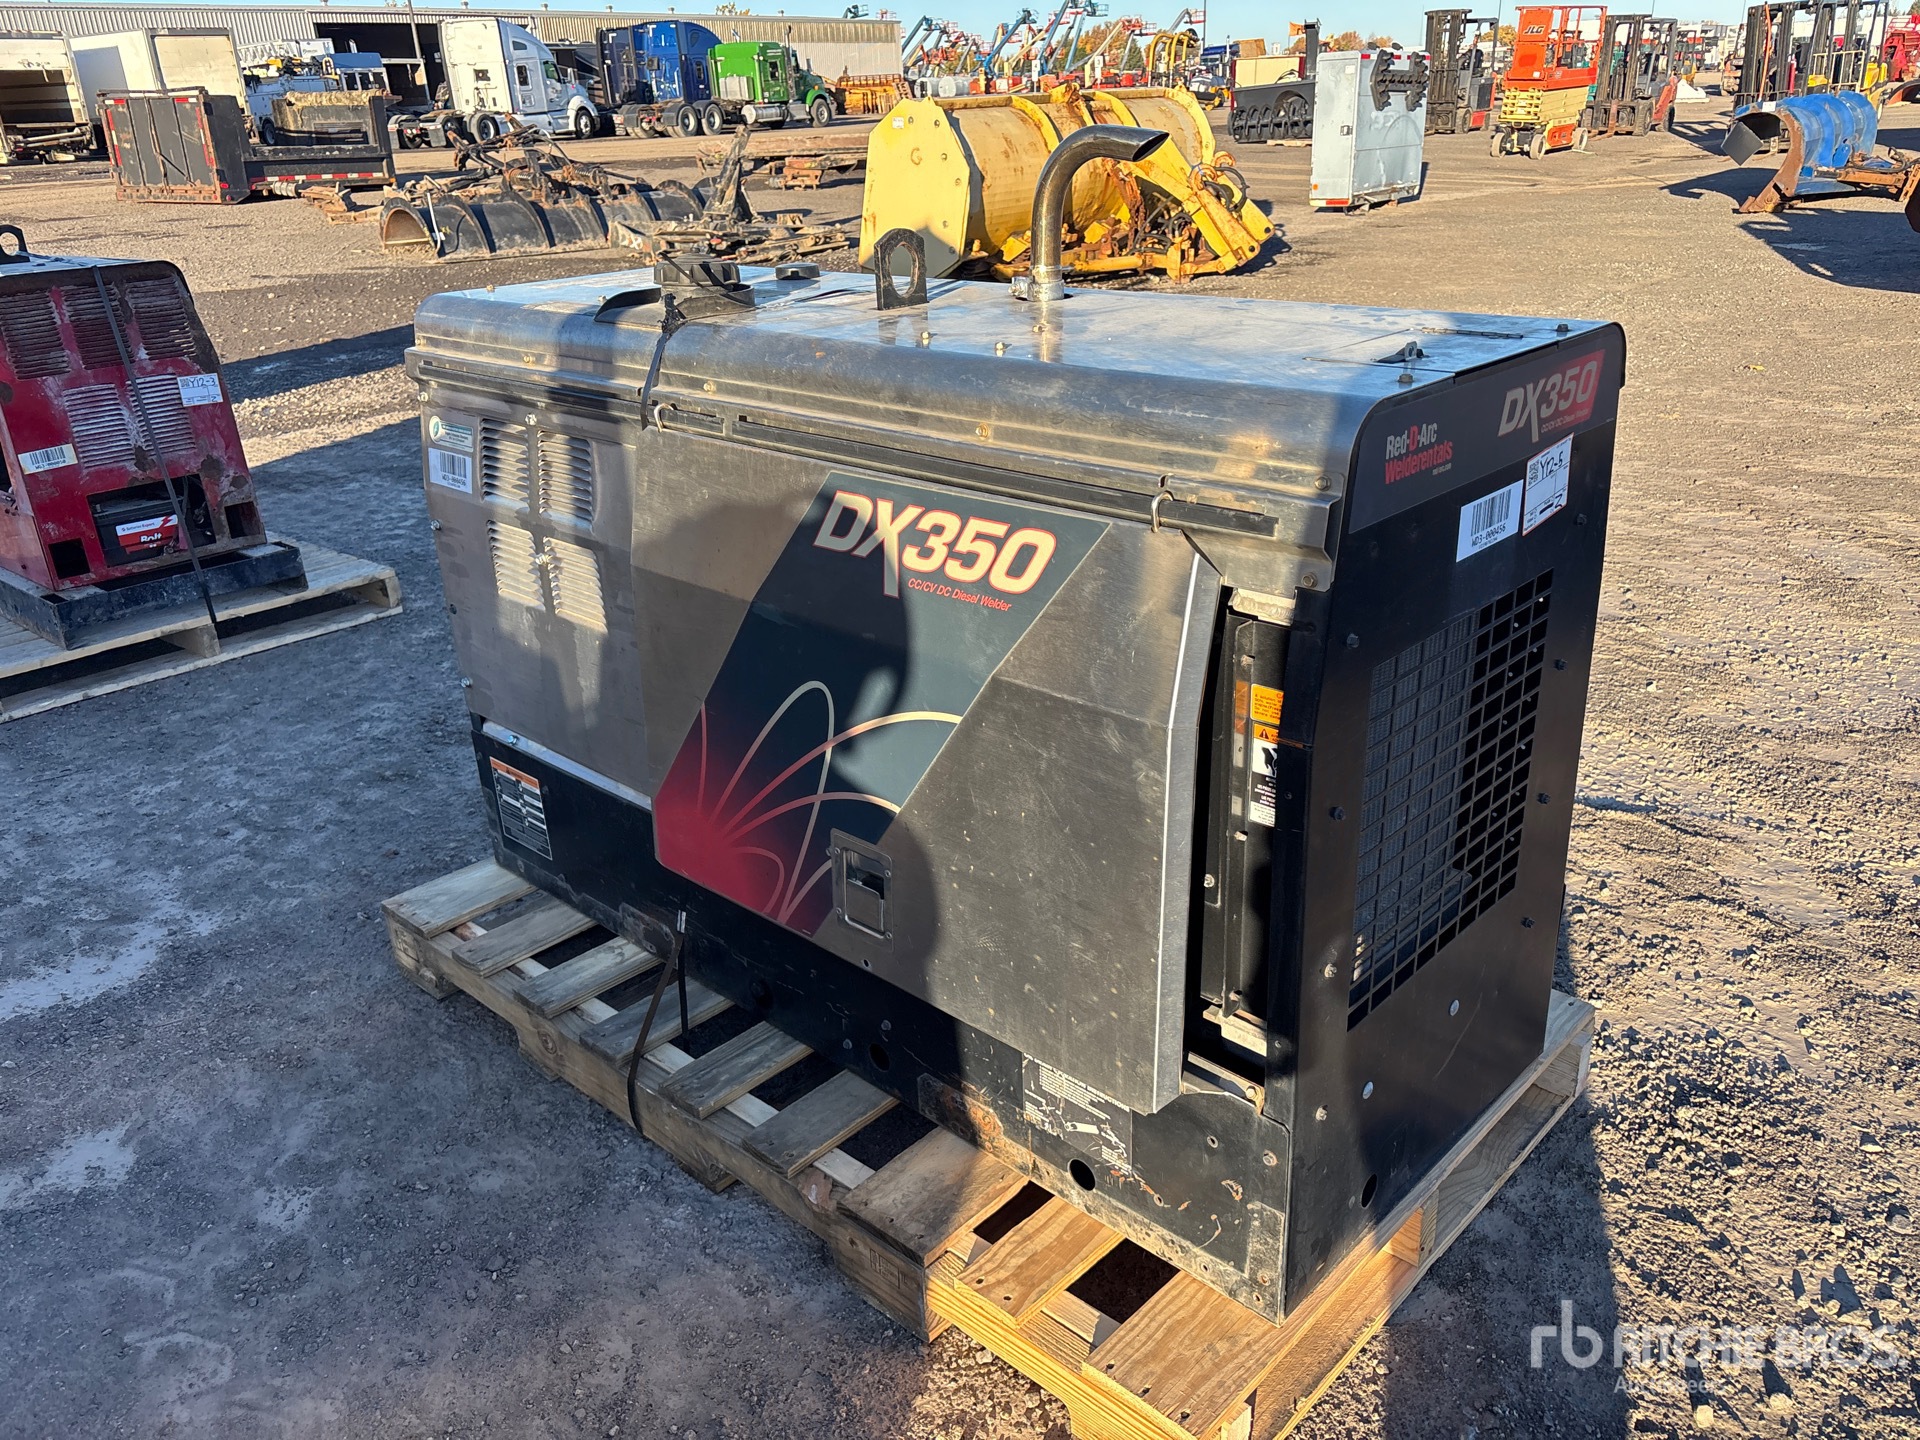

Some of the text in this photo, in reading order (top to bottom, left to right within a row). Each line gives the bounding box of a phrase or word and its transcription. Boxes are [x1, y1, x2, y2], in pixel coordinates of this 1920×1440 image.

[1523, 25, 1545, 35] JLG
[189, 377, 216, 388] Y12-3
[1497, 360, 1598, 443] DX350
[1385, 422, 1438, 460] Red-D-Arc
[1385, 440, 1453, 485] Welderentals
[812, 489, 1057, 599] DX350
[1471, 523, 1506, 547] WD3-000456
[908, 577, 1013, 612] CC/CV DC Diesel Welder
